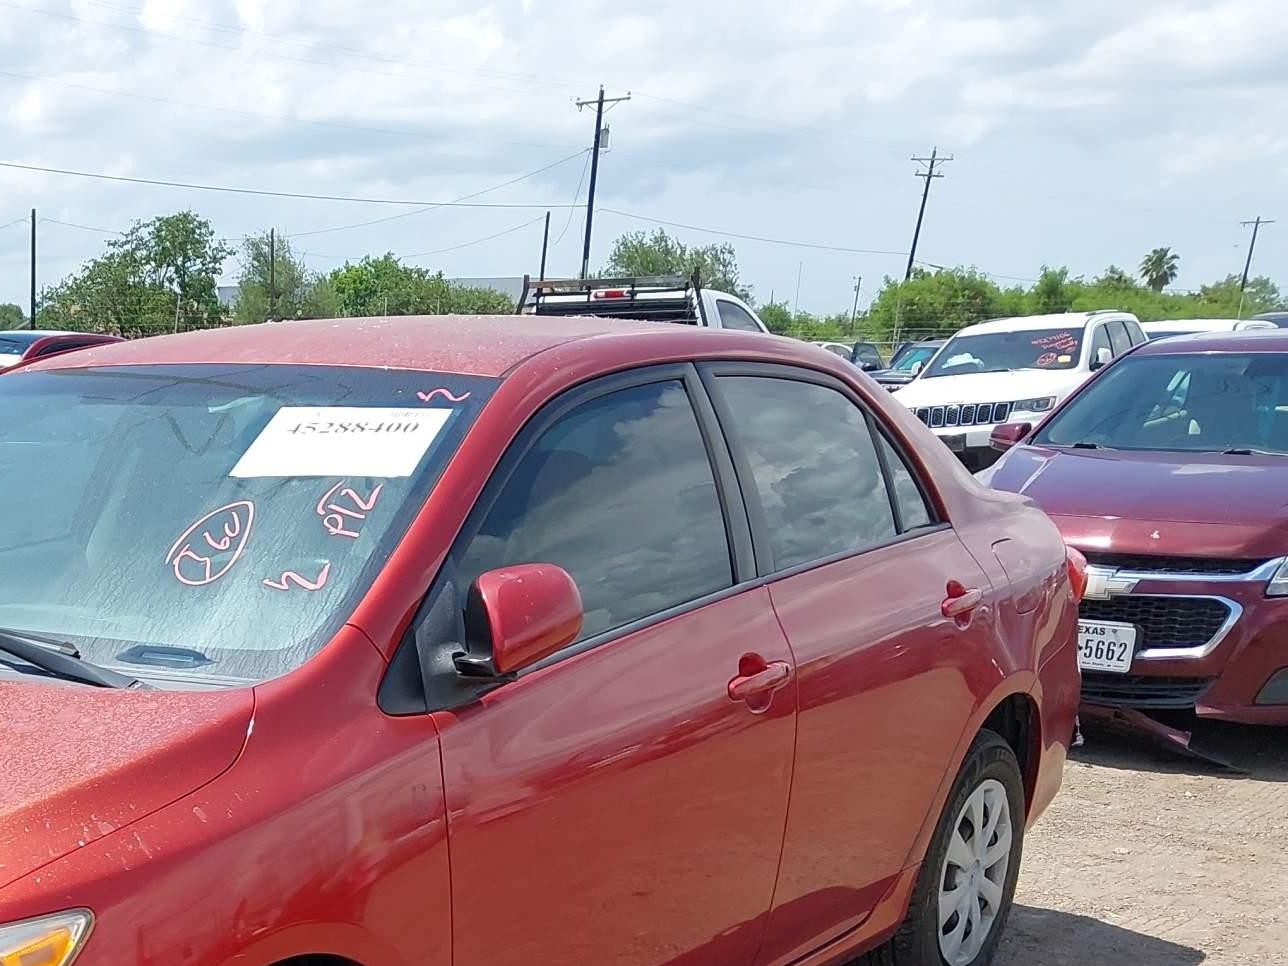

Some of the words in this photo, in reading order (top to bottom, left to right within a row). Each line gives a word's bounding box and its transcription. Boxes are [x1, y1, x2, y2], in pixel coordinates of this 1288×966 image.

[286, 422, 420, 434] 45288400
[1078, 625, 1105, 635] EXAS
[1082, 639, 1127, 661] 5662
